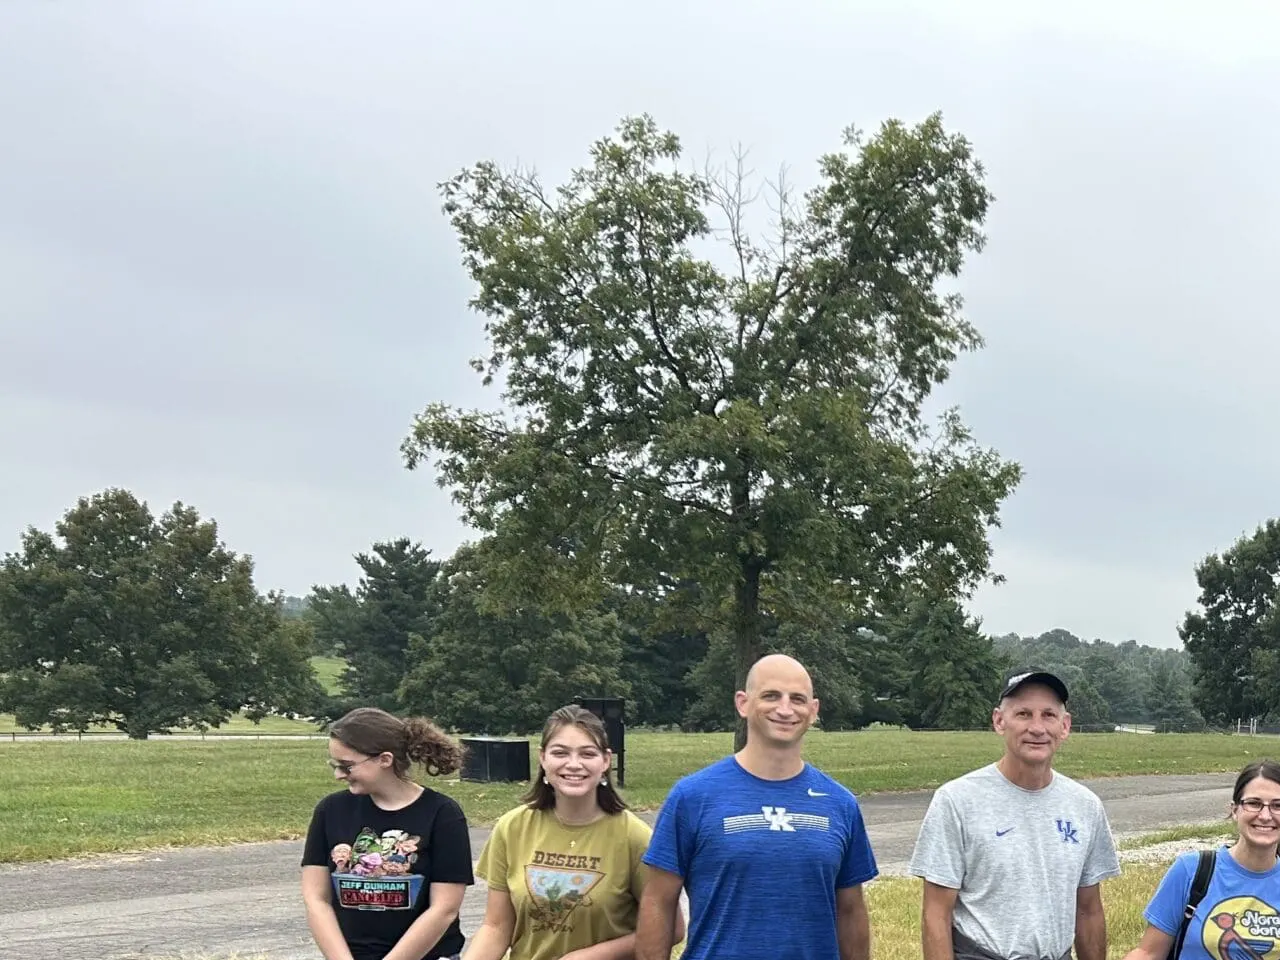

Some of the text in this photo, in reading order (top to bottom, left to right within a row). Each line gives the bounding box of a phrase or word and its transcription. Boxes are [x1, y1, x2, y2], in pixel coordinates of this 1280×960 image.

[761, 806, 796, 832] UK
[1056, 820, 1079, 843] UK
[532, 851, 602, 869] DESERT
[341, 881, 405, 891] JEFF DUNHAM
